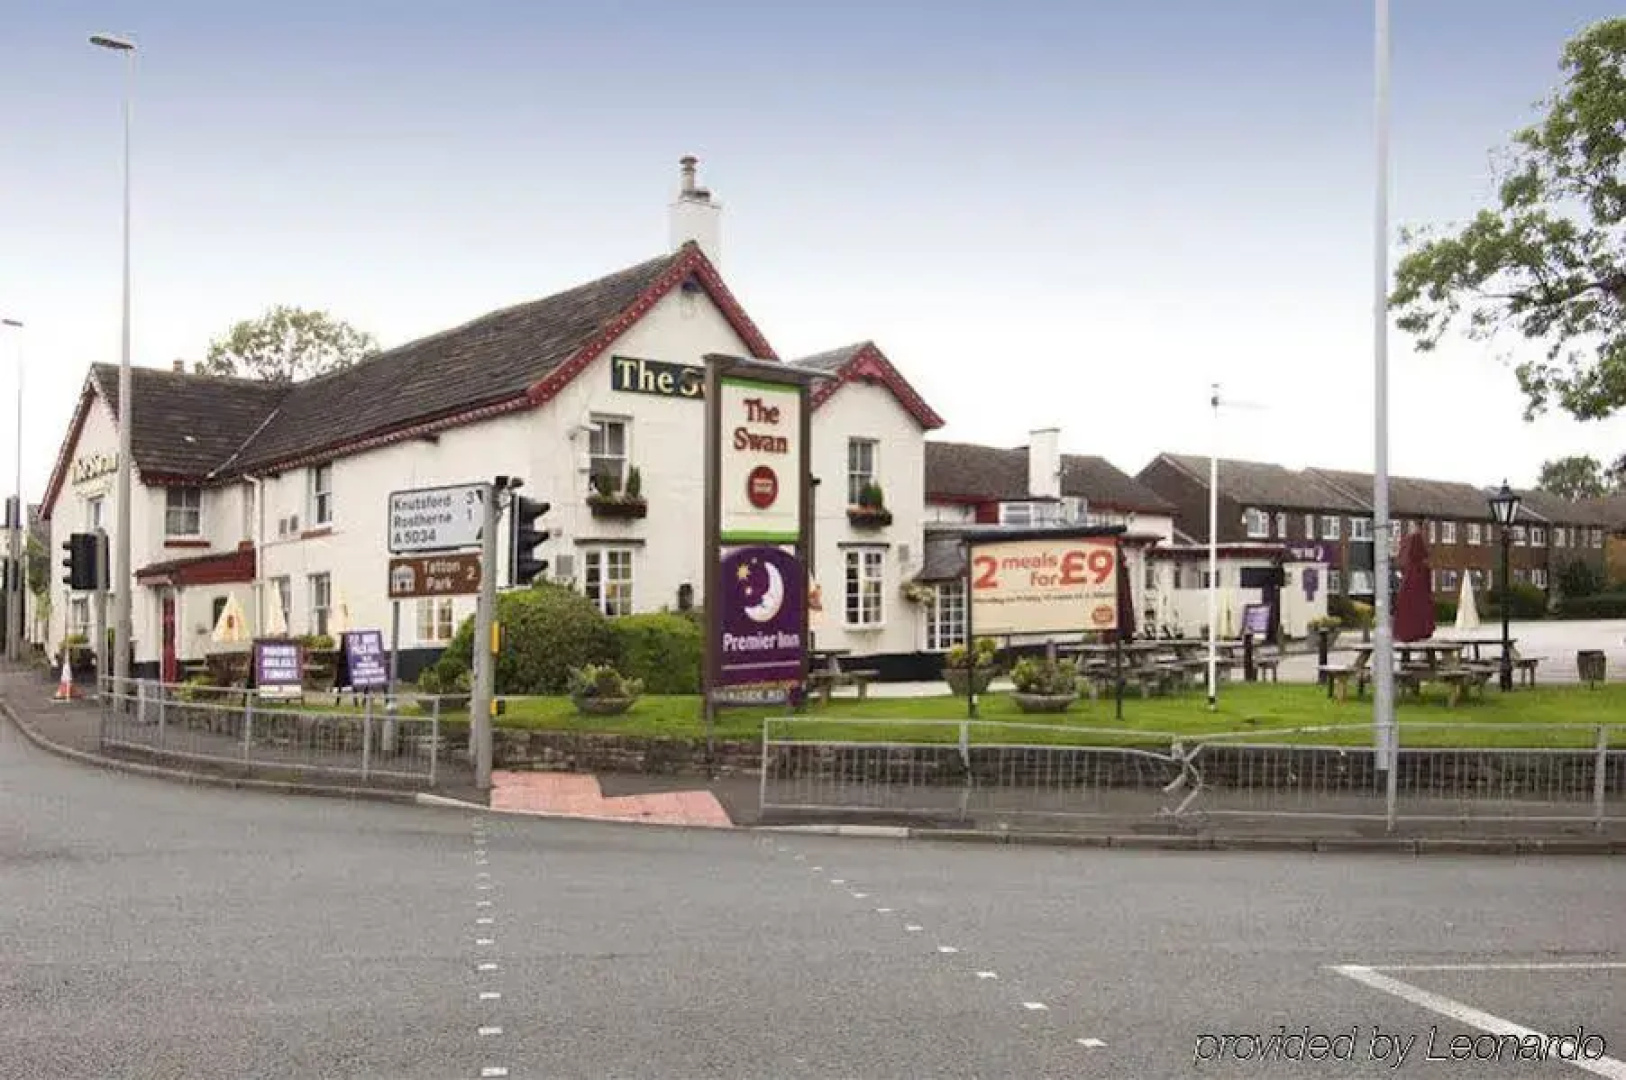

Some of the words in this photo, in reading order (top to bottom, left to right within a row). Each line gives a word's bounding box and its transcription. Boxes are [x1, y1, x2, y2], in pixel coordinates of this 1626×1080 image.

[616, 360, 674, 394] The
[680, 367, 707, 396] S
[743, 398, 780, 424] The
[733, 427, 788, 454] Swan
[394, 495, 452, 511] Knutsford
[466, 491, 475, 505] 3
[422, 559, 461, 575] Tatton
[466, 565, 478, 580] 2
[1002, 552, 1059, 569] meals
[1060, 550, 1116, 585] £9
[973, 555, 998, 589] 2
[1030, 571, 1060, 587] for
[426, 576, 455, 590] Park
[722, 631, 777, 652] Premier
[778, 631, 800, 648] Inn
